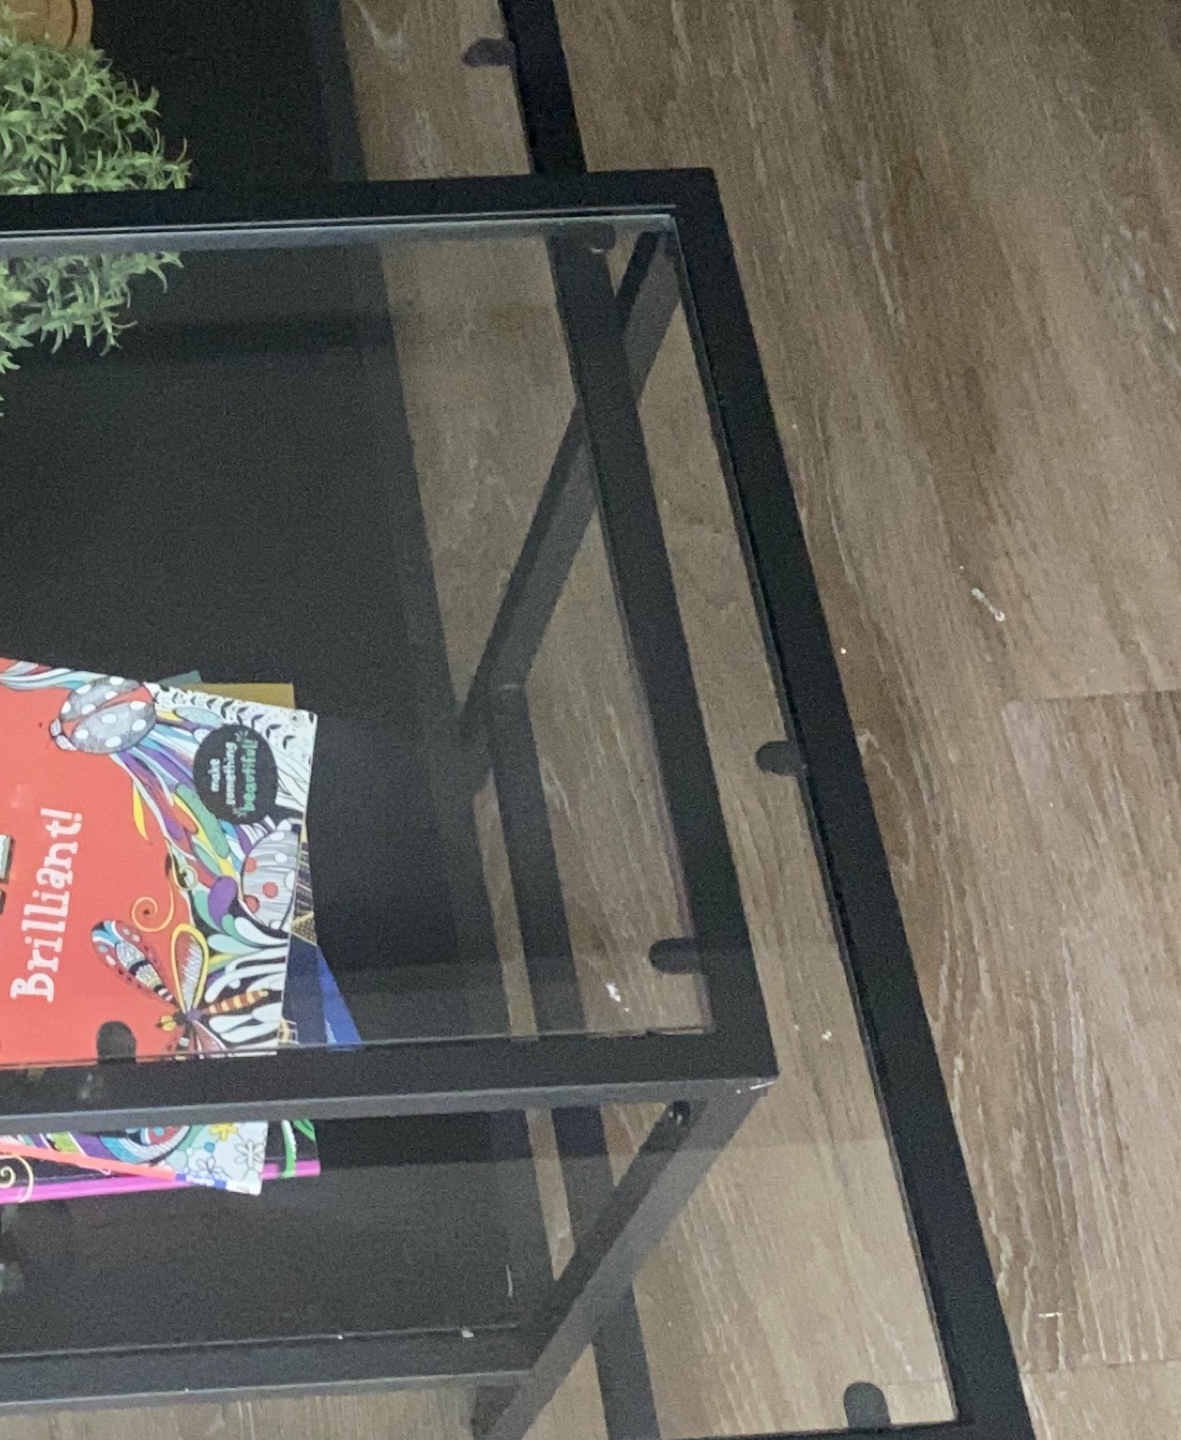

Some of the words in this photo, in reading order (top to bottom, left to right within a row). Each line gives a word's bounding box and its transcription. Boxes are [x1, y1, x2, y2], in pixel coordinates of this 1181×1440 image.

[207, 757, 221, 792] make
[222, 741, 237, 805] something
[240, 739, 258, 812] beautiful!
[10, 807, 83, 1003] Brilliant!
